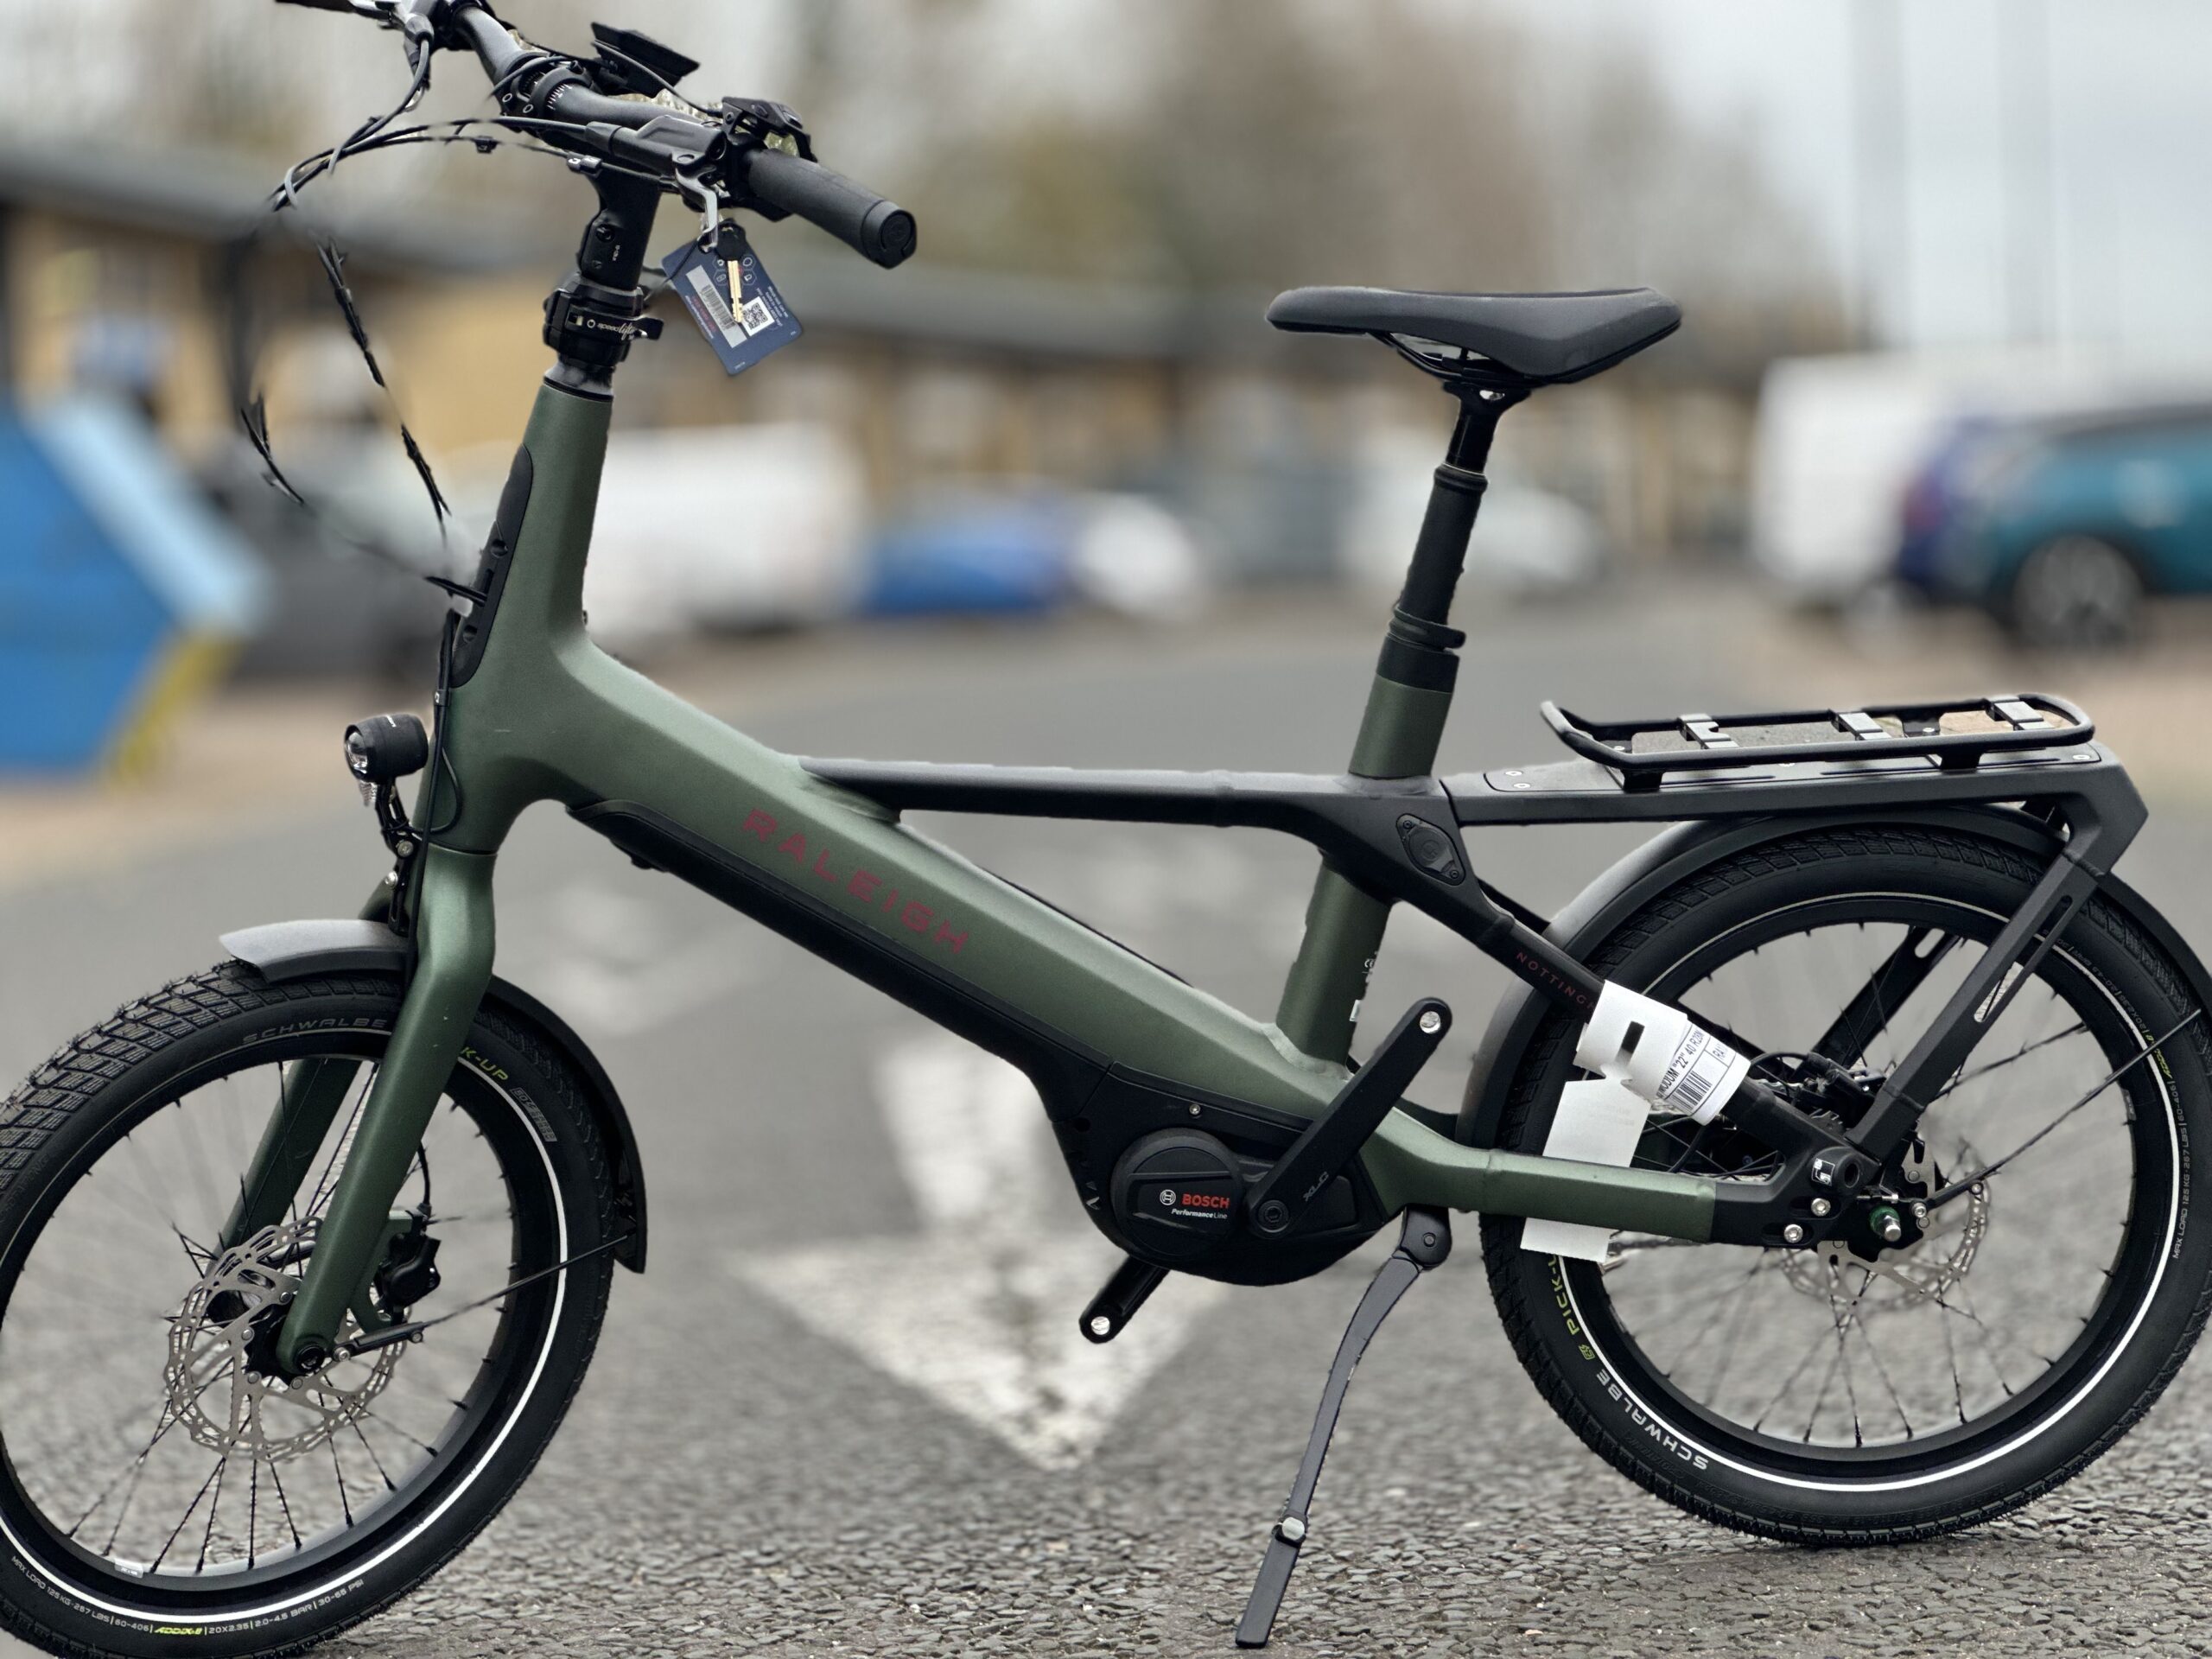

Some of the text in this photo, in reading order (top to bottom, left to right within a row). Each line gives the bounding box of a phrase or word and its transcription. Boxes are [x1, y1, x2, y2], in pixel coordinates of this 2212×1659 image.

[743, 808, 969, 953] RALEIGH
[242, 1018, 389, 1045] SCHWALBE
[1181, 1193, 1230, 1209] BOSCH
[1597, 1369, 1709, 1470] SCHWALBE
[11, 1555, 27, 1573] MAX
[26, 1570, 46, 1590] LOAD
[47, 1586, 60, 1599] 125
[290, 1604, 312, 1618] BAR
